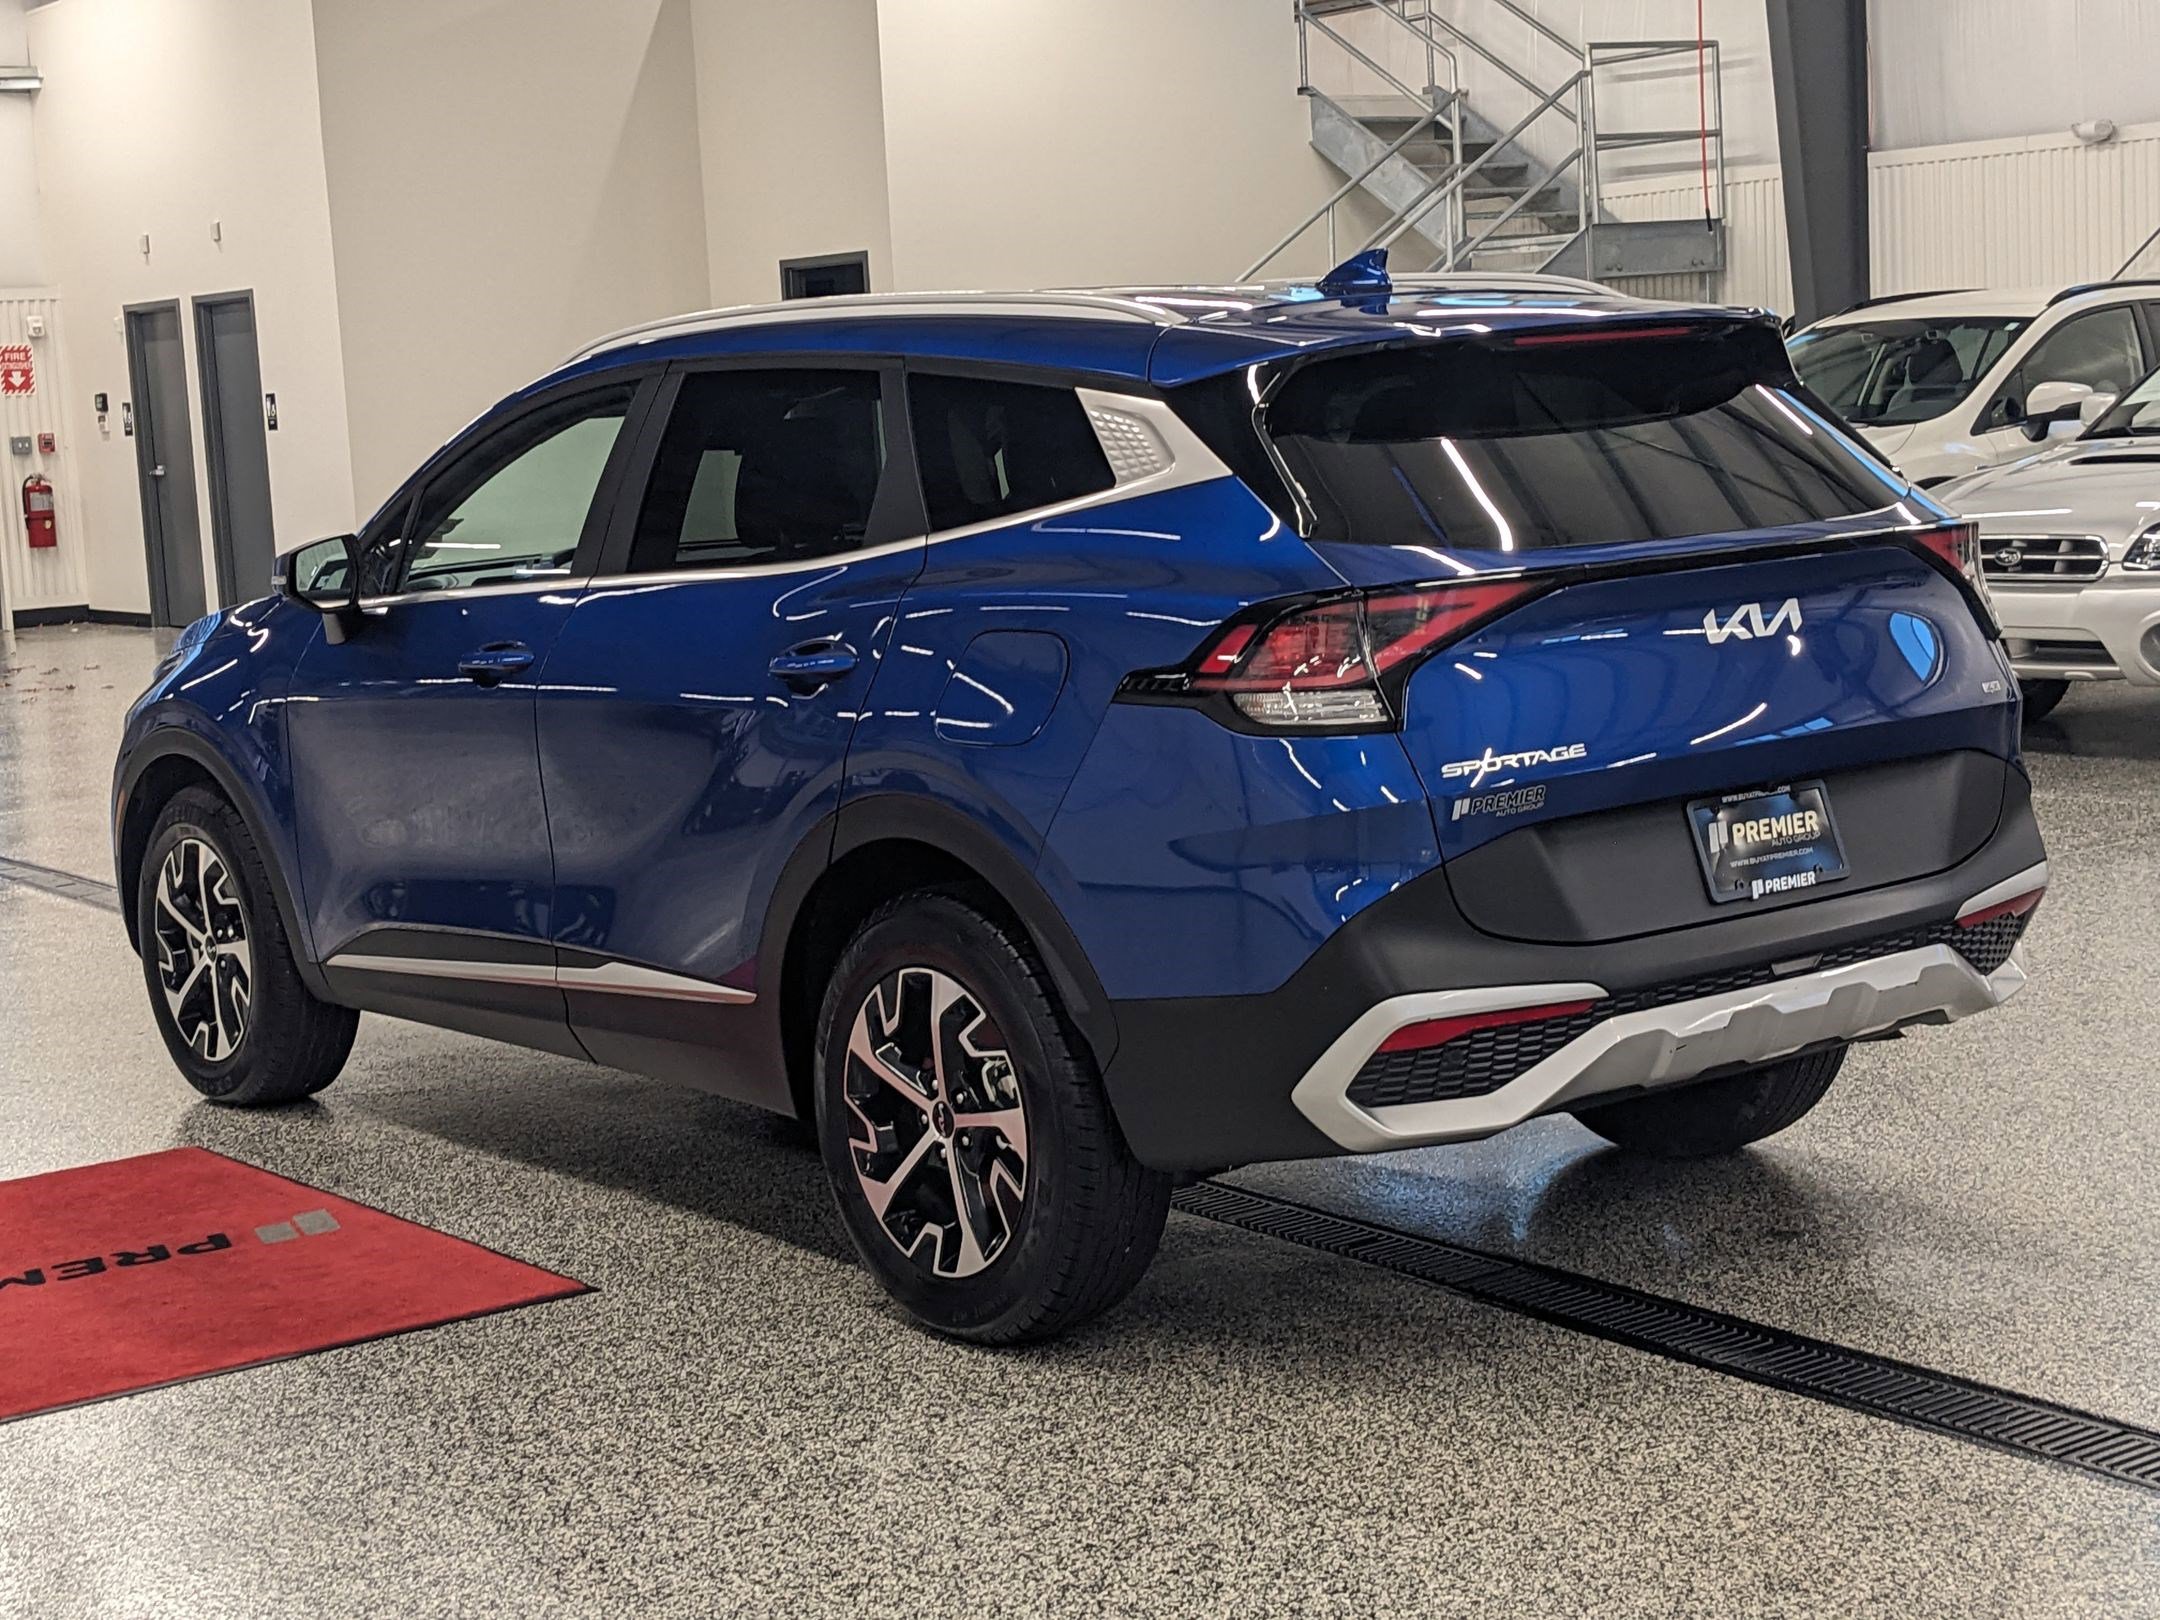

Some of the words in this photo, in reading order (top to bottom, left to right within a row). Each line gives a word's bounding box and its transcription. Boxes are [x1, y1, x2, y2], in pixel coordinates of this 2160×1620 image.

[4, 352, 26, 361] FIRE
[1703, 598, 1802, 644] KIA
[1441, 743, 1587, 788] SPORTAGE
[1471, 784, 1546, 815] PREMIER
[1496, 807, 1517, 817] AUTO
[1732, 810, 1819, 846] PREMIER
[1771, 836, 1793, 847] AUTO
[1793, 831, 1821, 843] GROUP
[1730, 847, 1814, 868] WWW.BUYATPREMIER.COM
[1765, 871, 1816, 894] PREMIER
